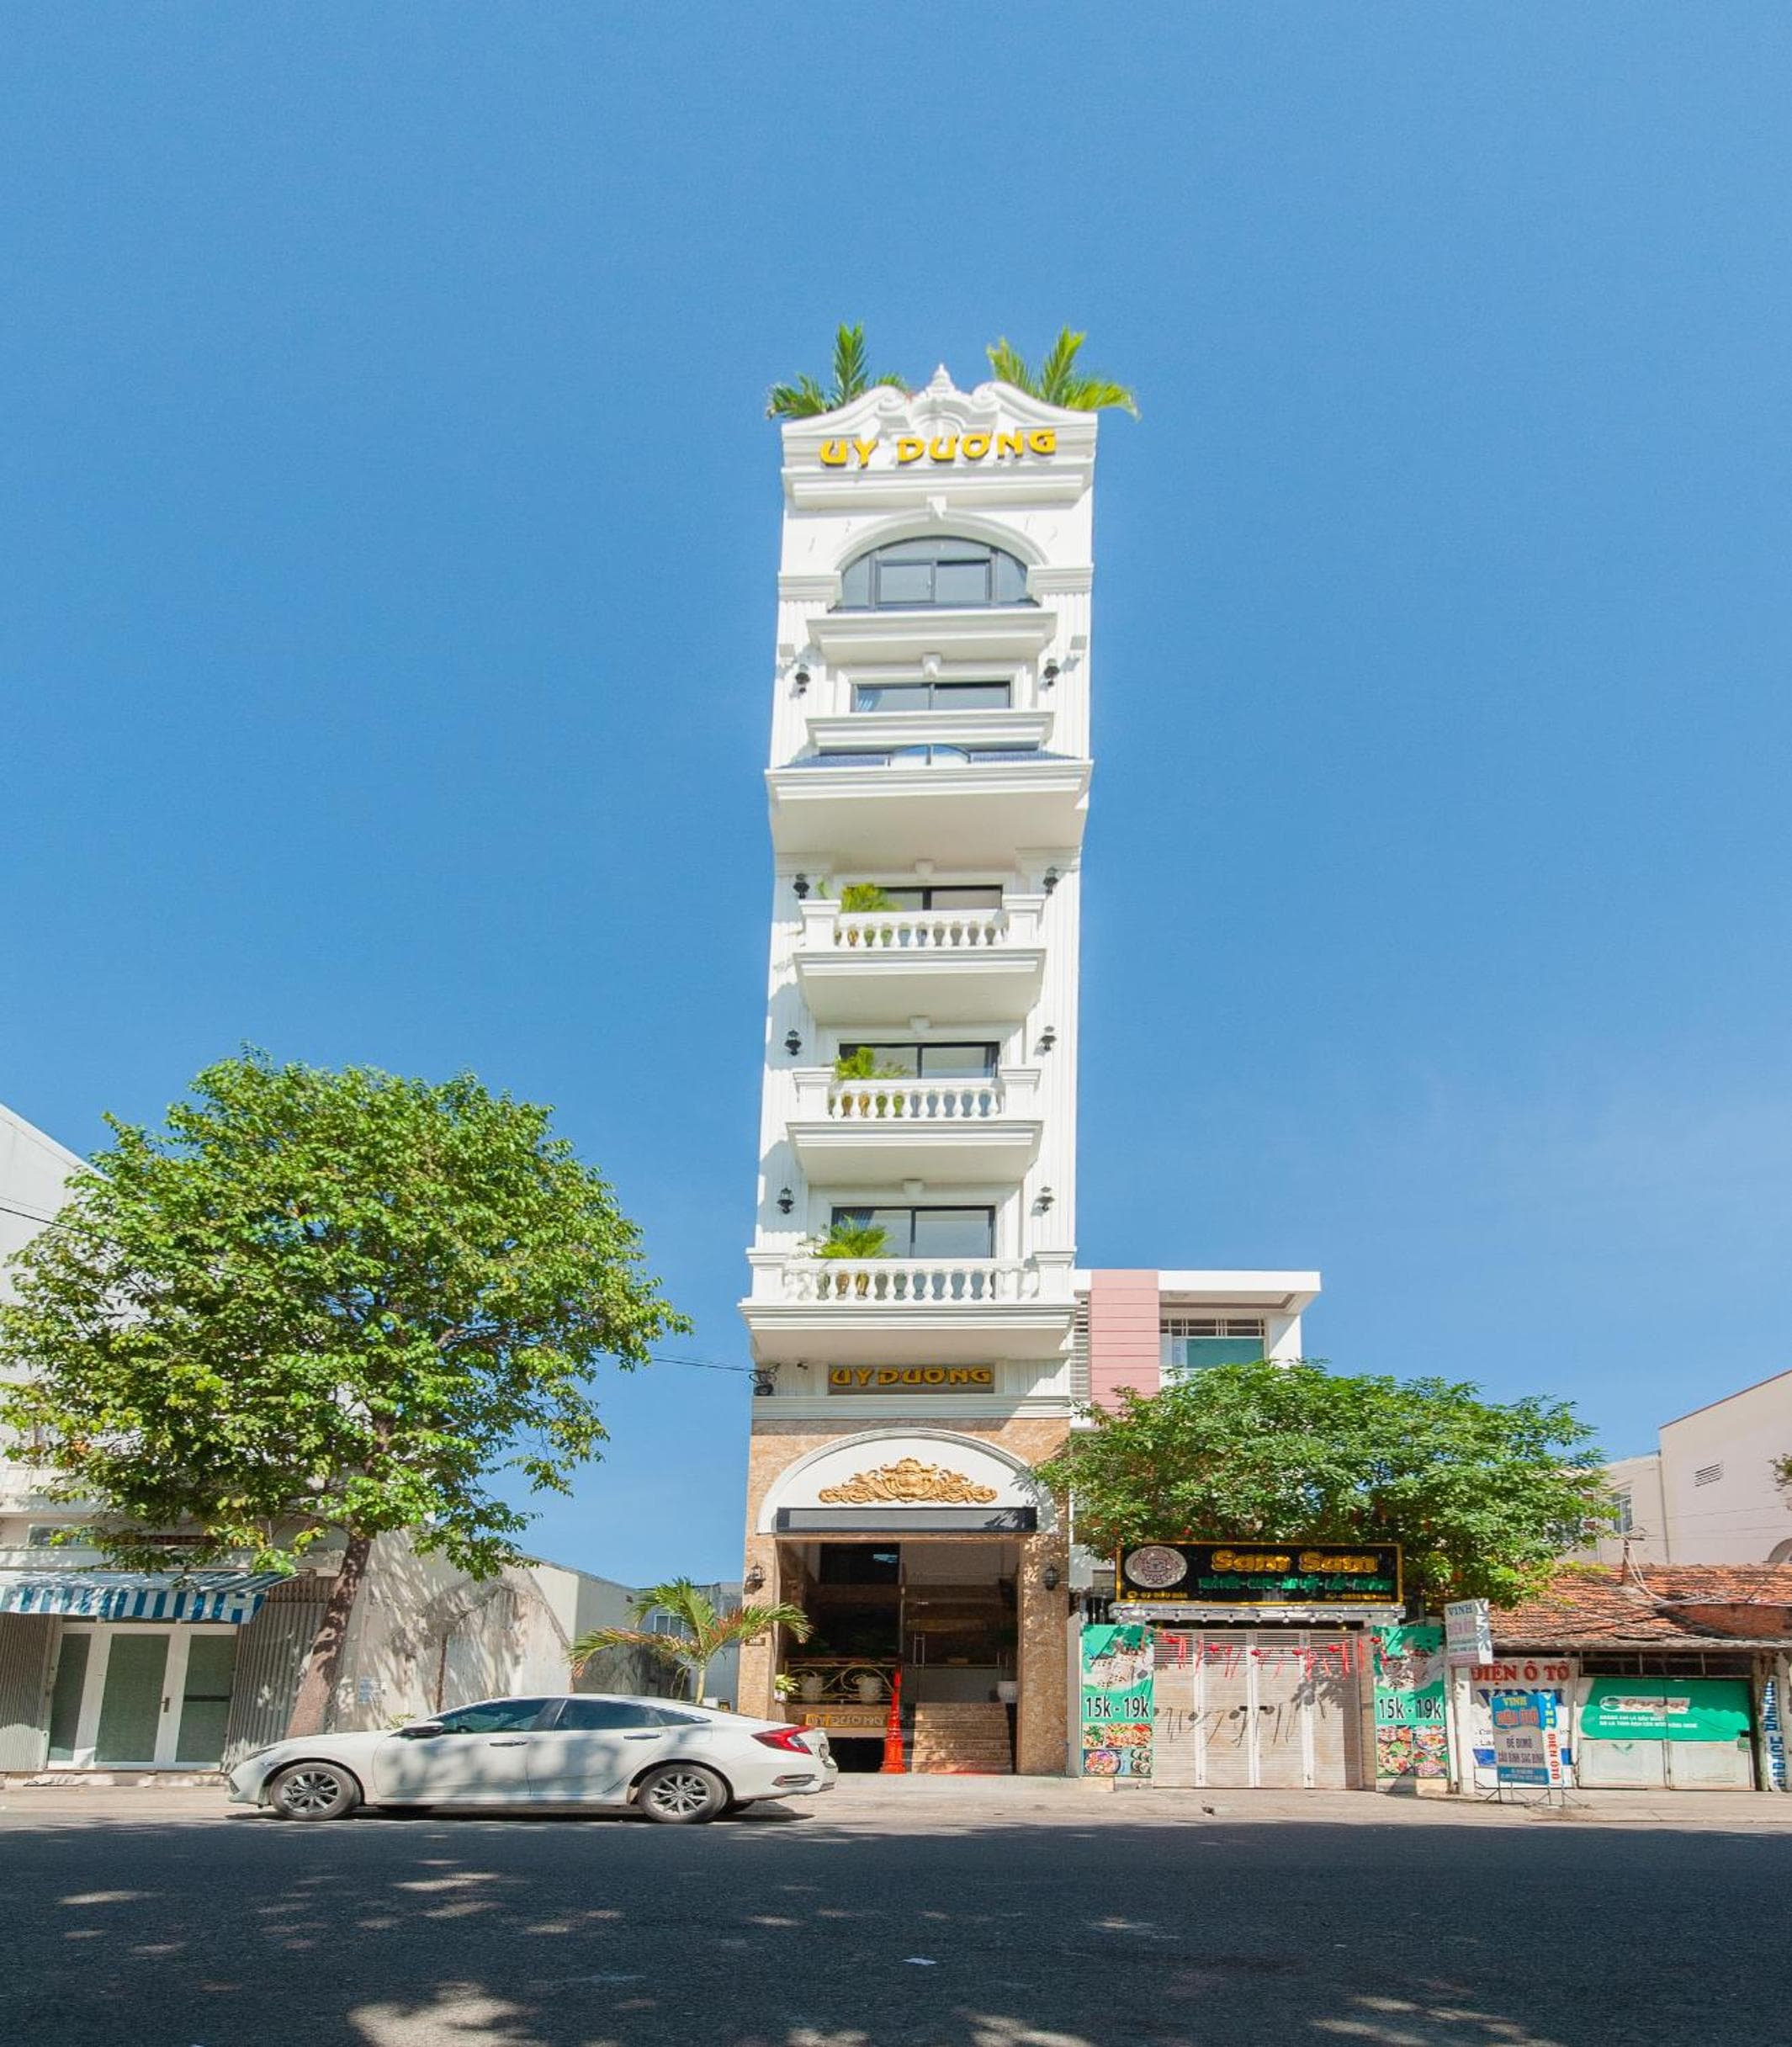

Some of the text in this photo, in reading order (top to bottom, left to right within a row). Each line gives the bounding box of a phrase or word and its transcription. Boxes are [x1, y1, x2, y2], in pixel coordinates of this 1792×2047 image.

[820, 437, 878, 468] UY
[830, 1366, 872, 1387] UY
[1544, 1660, 1570, 1681] TÔ
[1085, 1696, 1111, 1718] 15k
[1124, 1696, 1149, 1718] 19k
[1379, 1696, 1404, 1719] 15k
[1416, 1696, 1442, 1720] 19k
